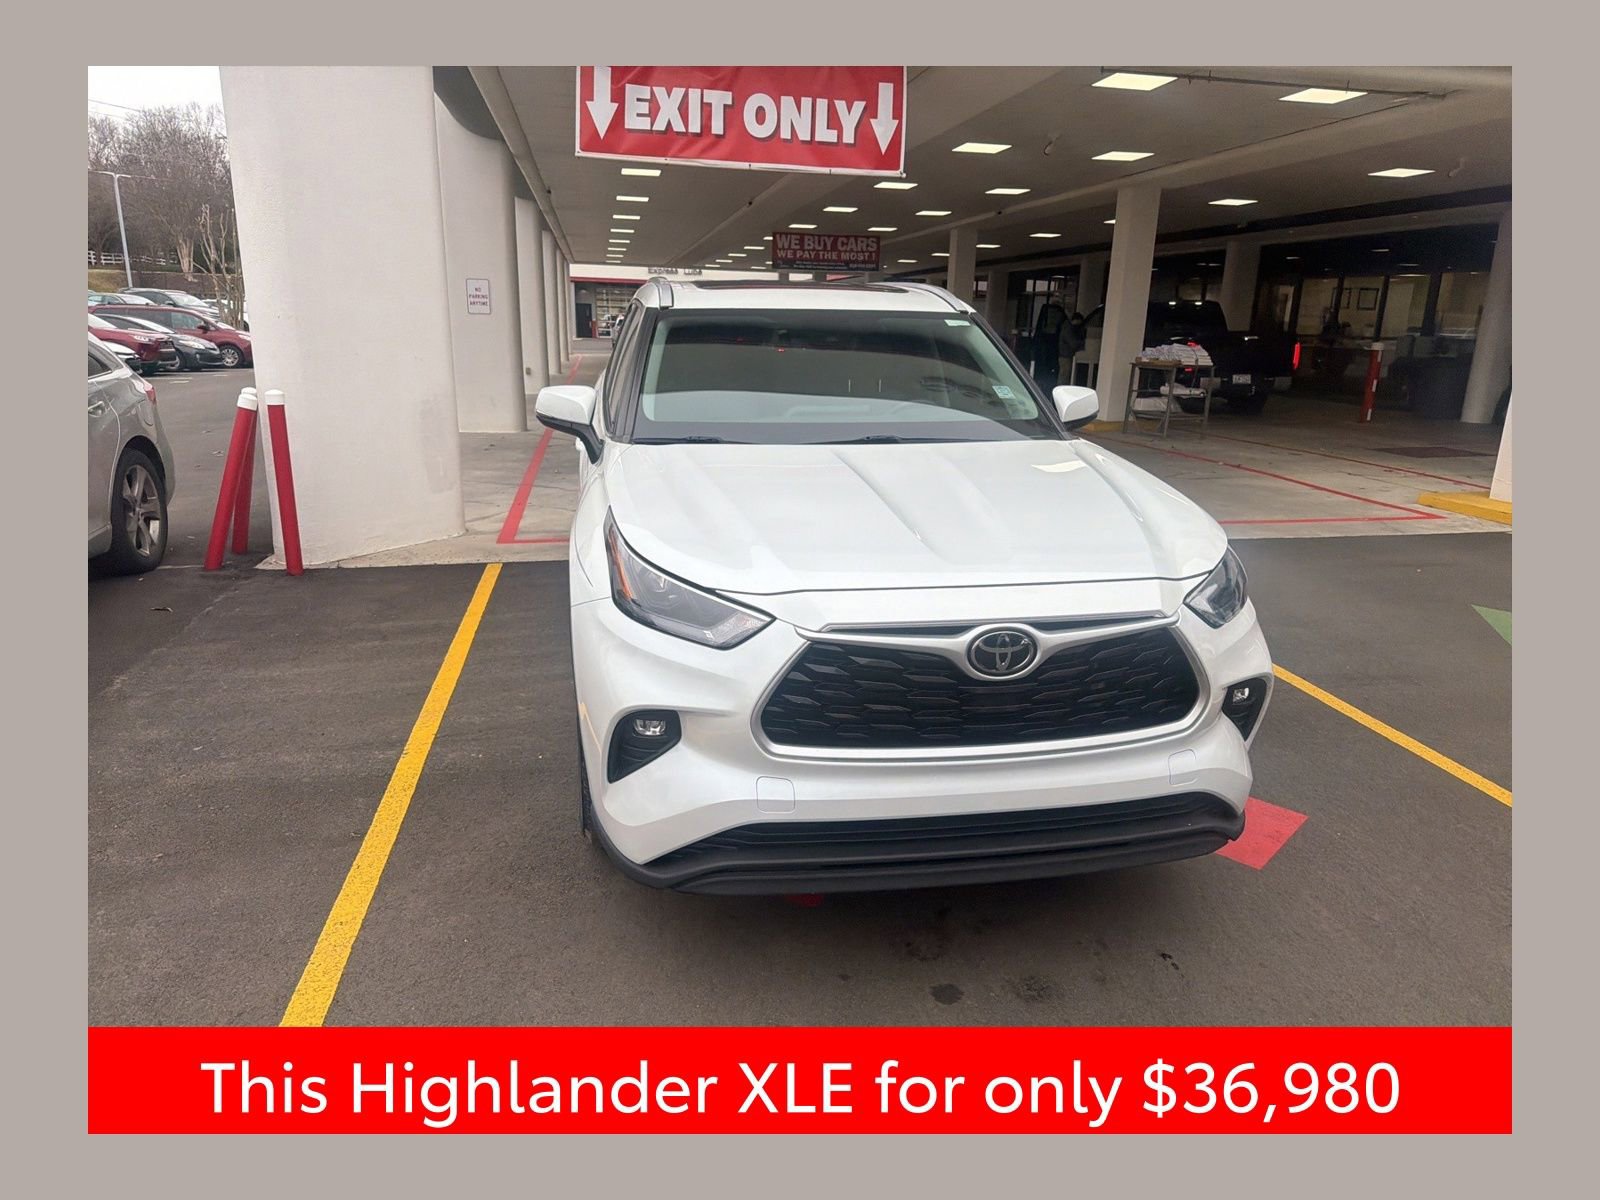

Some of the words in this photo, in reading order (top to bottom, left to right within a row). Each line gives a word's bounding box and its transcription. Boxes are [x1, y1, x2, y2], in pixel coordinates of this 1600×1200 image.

[624, 83, 733, 136] EXIT
[743, 92, 867, 145] ONLY
[776, 234, 800, 249] WE
[803, 234, 834, 251] BUY
[837, 237, 877, 251] CARS
[777, 250, 793, 258] WE
[797, 251, 817, 259] PAY
[819, 251, 838, 260] THE
